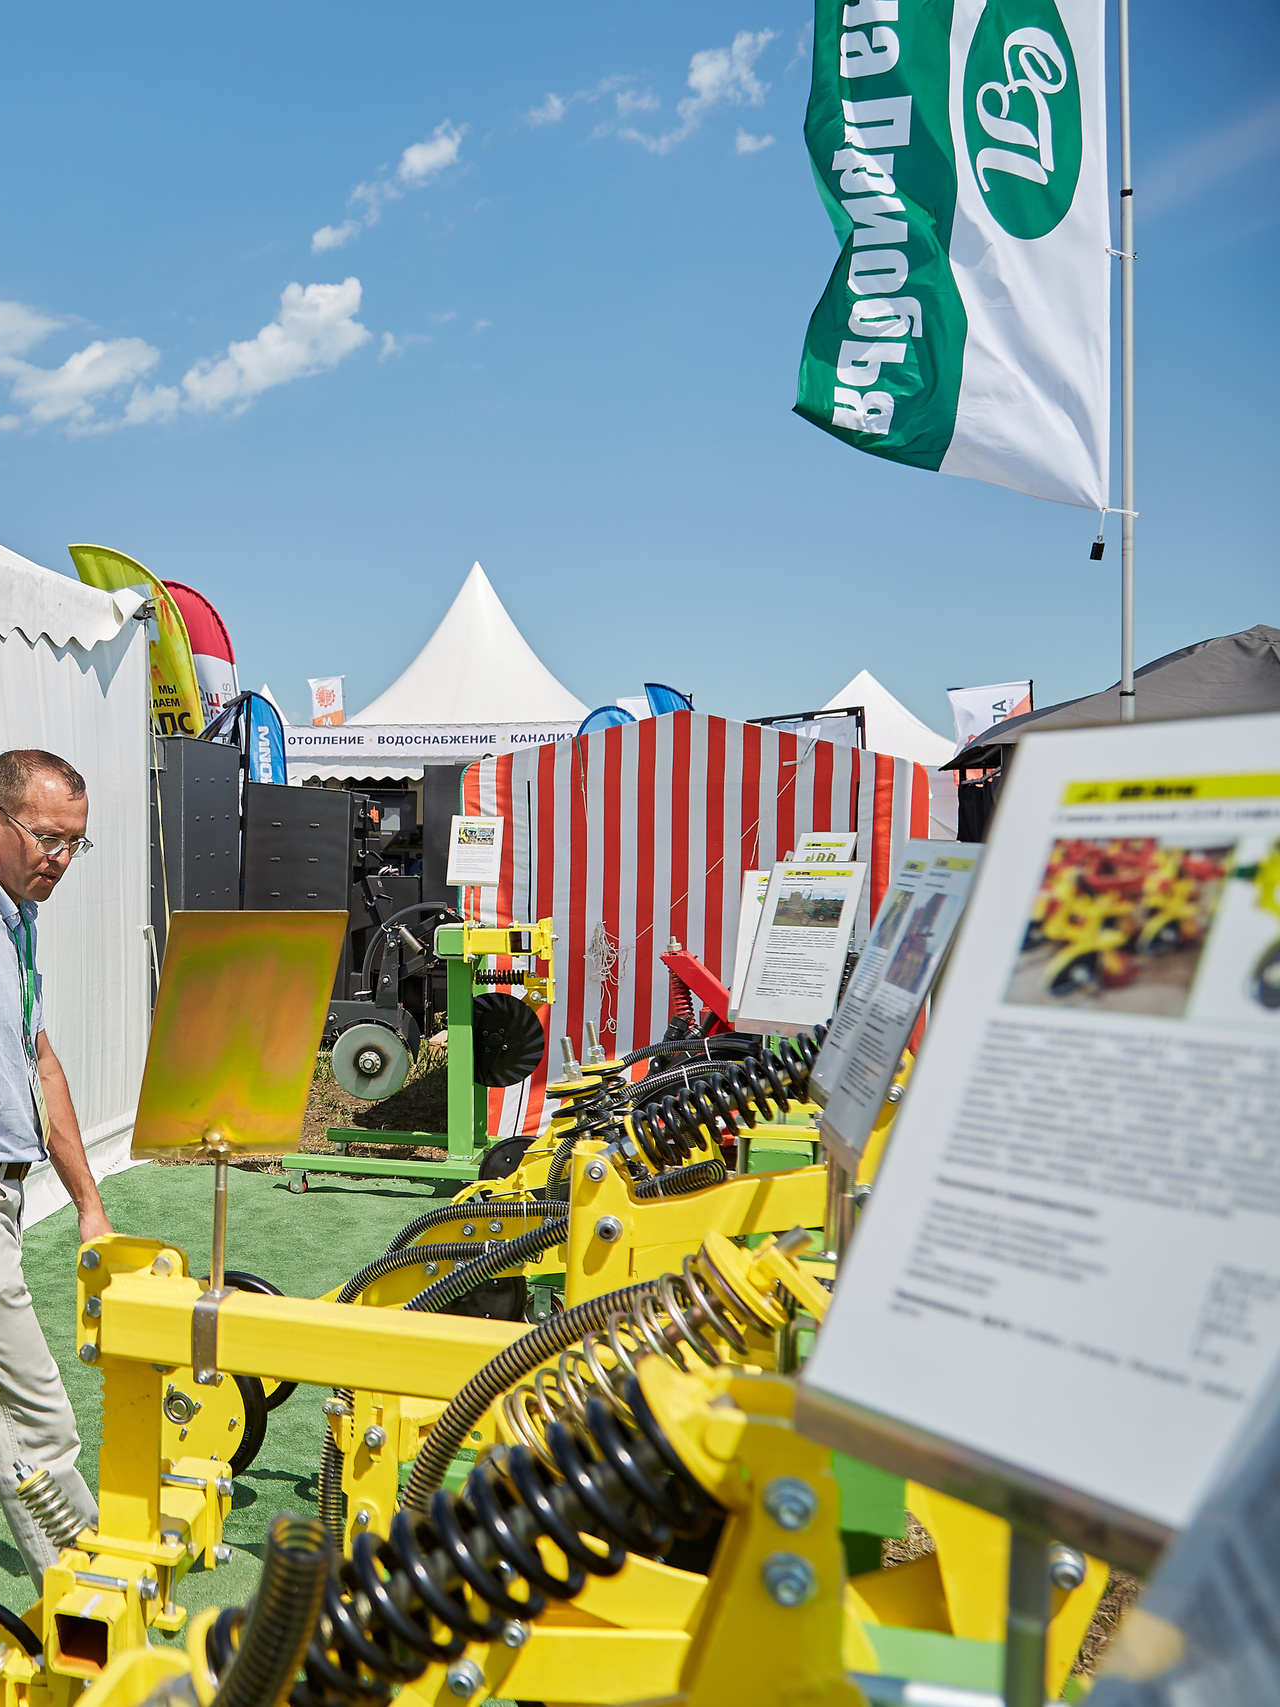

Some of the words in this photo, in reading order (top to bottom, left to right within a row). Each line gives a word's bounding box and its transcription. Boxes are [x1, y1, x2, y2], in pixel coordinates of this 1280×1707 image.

[831, 95, 923, 436] Приобья
[158, 685, 177, 694] МЫ
[287, 735, 365, 745] ОТОПЛЕНИЕ
[377, 734, 497, 746] ВОДОСНАБЖЕНИЕ
